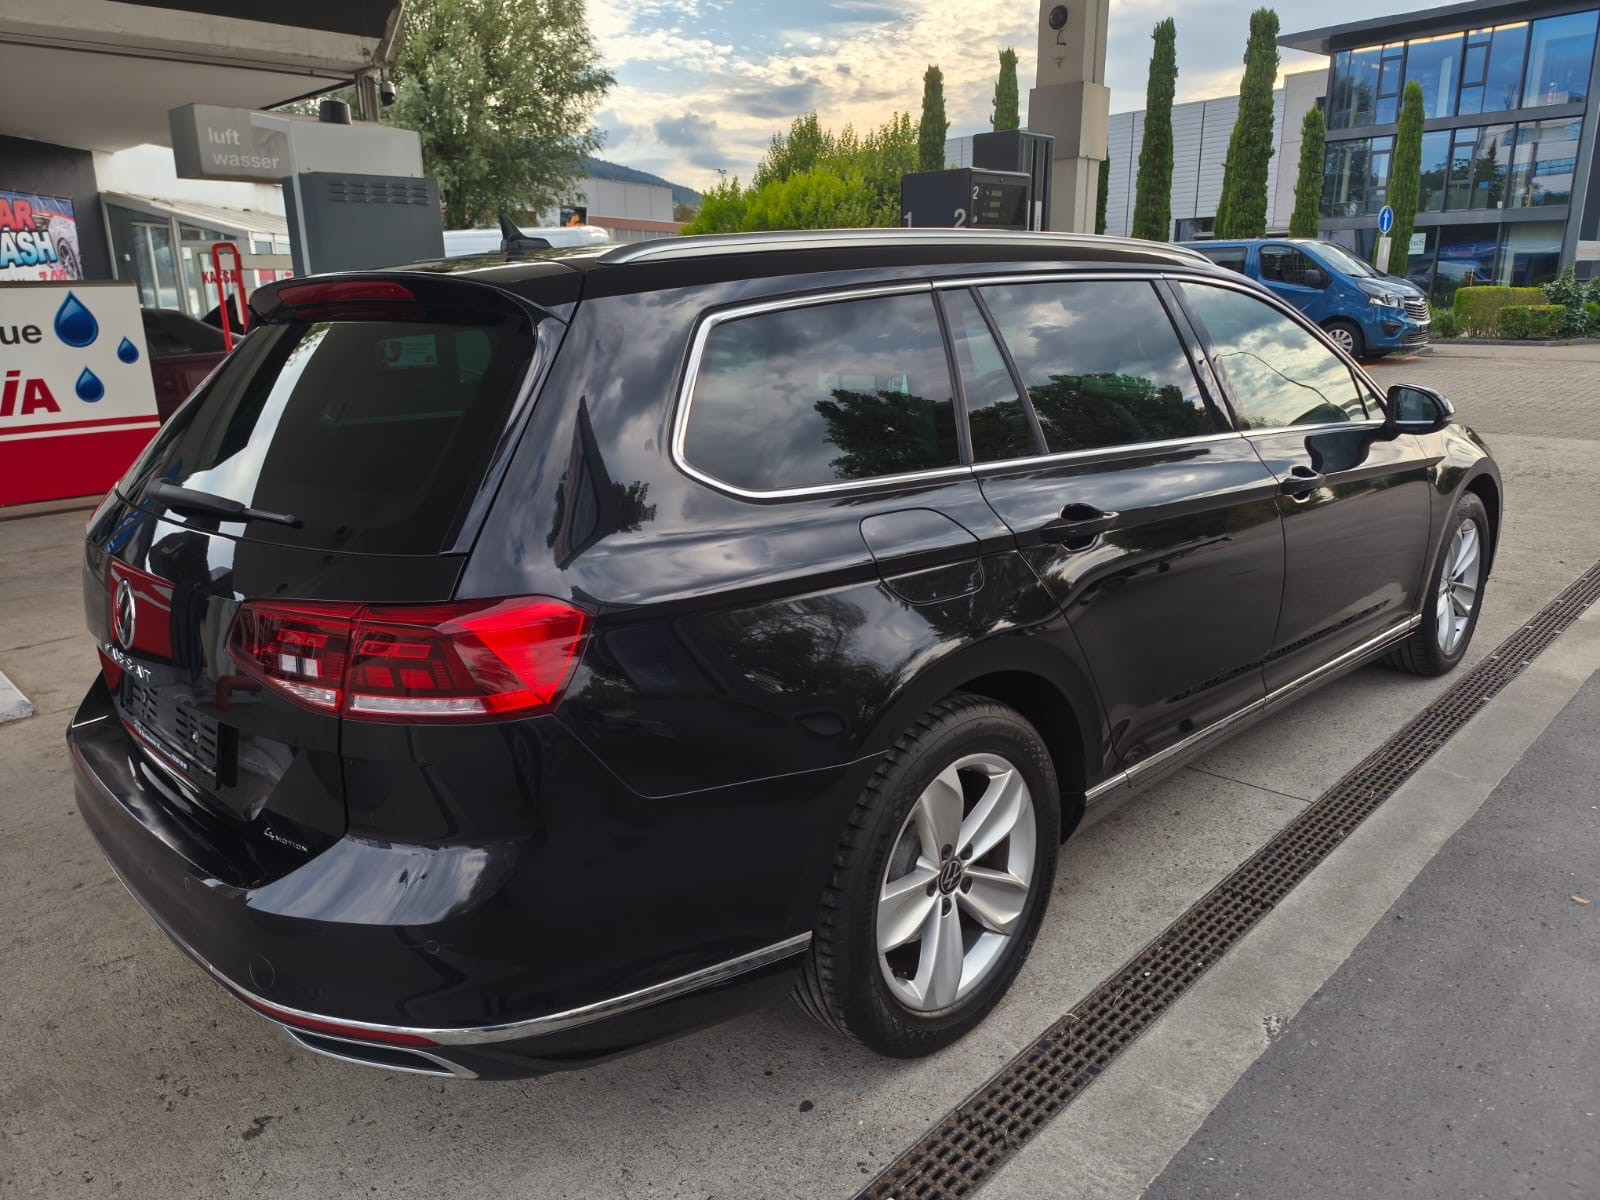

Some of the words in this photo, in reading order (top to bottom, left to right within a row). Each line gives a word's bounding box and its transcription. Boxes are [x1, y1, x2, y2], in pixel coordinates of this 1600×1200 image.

[208, 127, 240, 145] luft
[211, 152, 280, 169] wasser
[972, 185, 980, 200] 2
[903, 211, 913, 229] 1
[953, 208, 967, 229] 2
